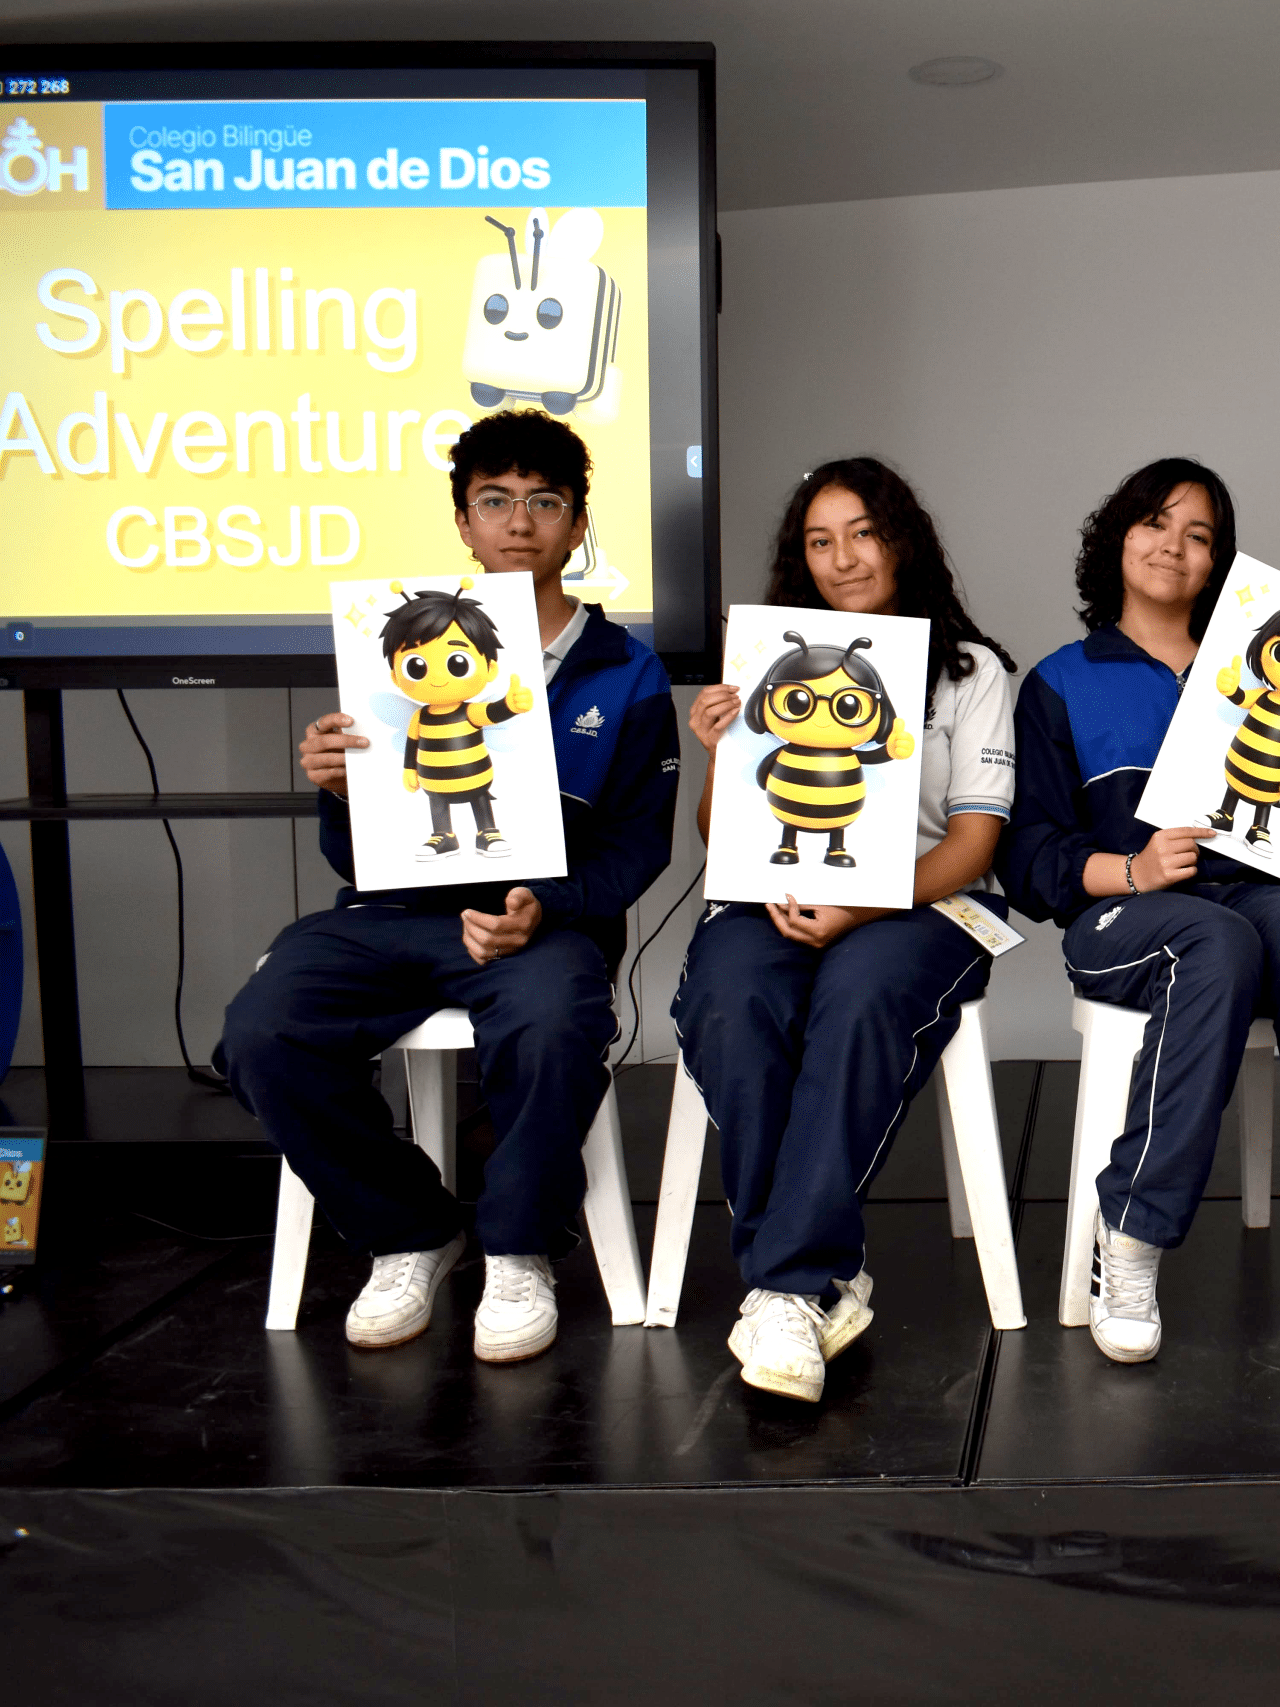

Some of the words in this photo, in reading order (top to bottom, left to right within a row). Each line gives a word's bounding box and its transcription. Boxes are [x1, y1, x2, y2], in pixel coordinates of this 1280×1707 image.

[9, 79, 37, 94] 272
[41, 79, 70, 94] 268
[129, 125, 217, 153] Colegio
[223, 124, 313, 152] Bilingüe
[130, 148, 225, 192] San
[233, 148, 357, 191] Juan
[366, 147, 430, 190] de
[439, 144, 551, 190] Dios
[35, 267, 418, 374] Spelling
[0, 391, 473, 474] Adventure
[106, 505, 361, 567] CBSJD
[171, 676, 216, 685] OneScreen
[980, 756, 993, 765] SAN
